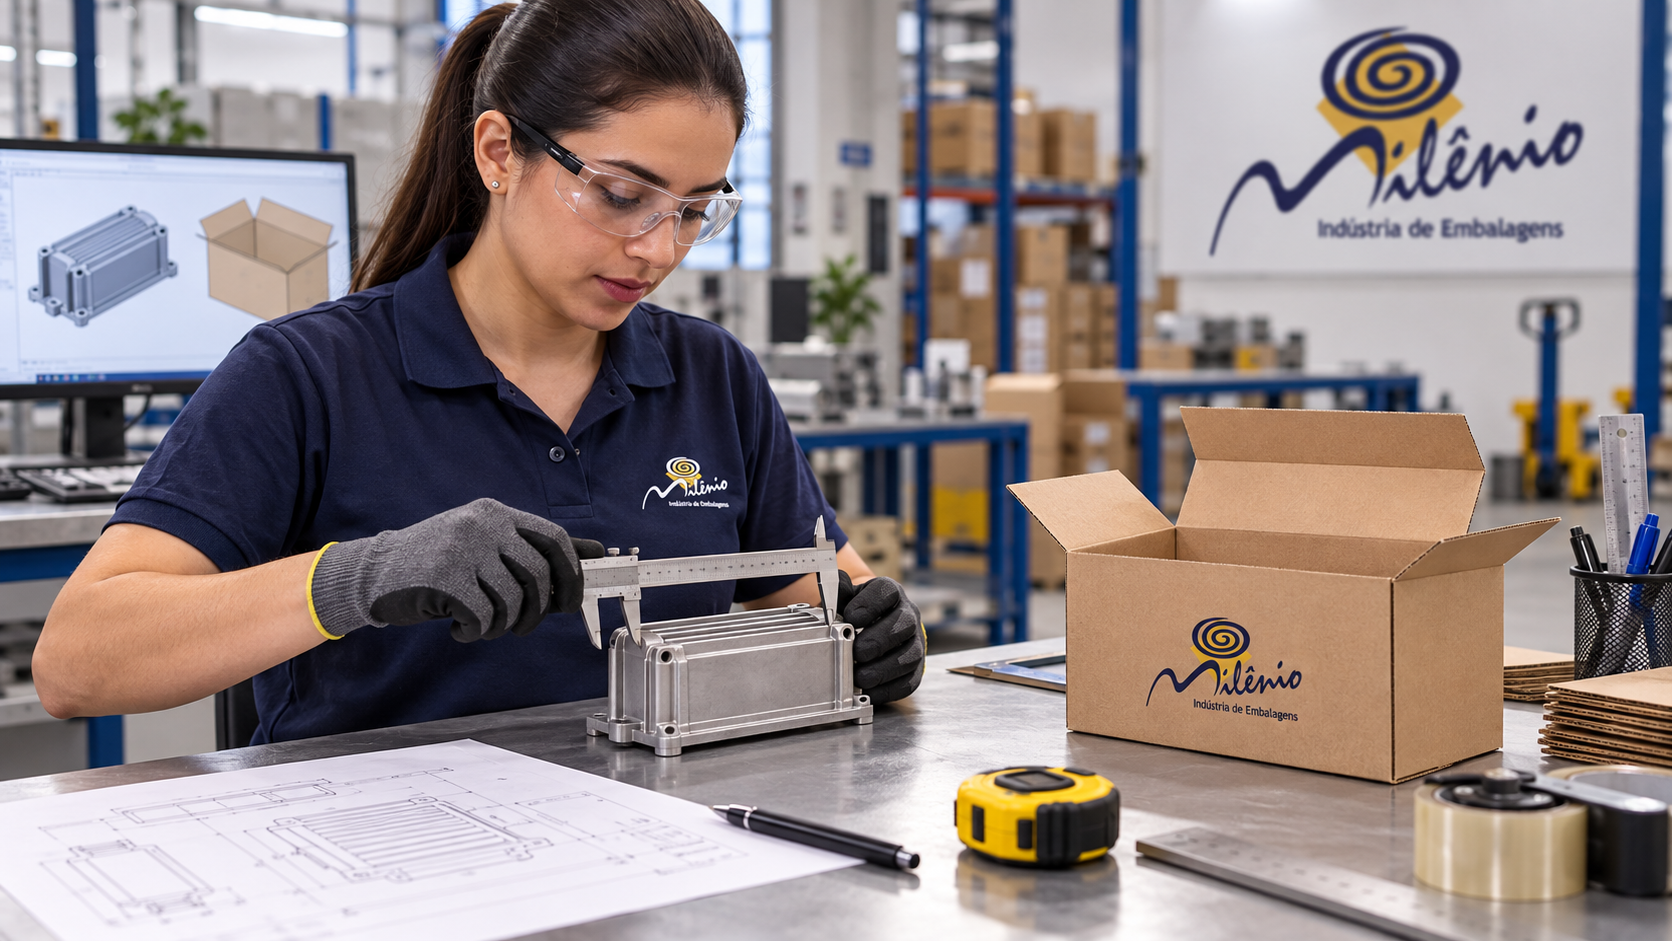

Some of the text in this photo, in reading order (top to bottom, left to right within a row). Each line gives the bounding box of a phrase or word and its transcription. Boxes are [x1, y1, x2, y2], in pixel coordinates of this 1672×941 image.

[1210, 104, 1584, 256] Milênio
[1317, 218, 1564, 243] Indústria de Embalagens
[642, 476, 728, 510] Milênio
[1146, 660, 1302, 707] Milênio
[1193, 698, 1299, 722] Indústria de Embalagens
